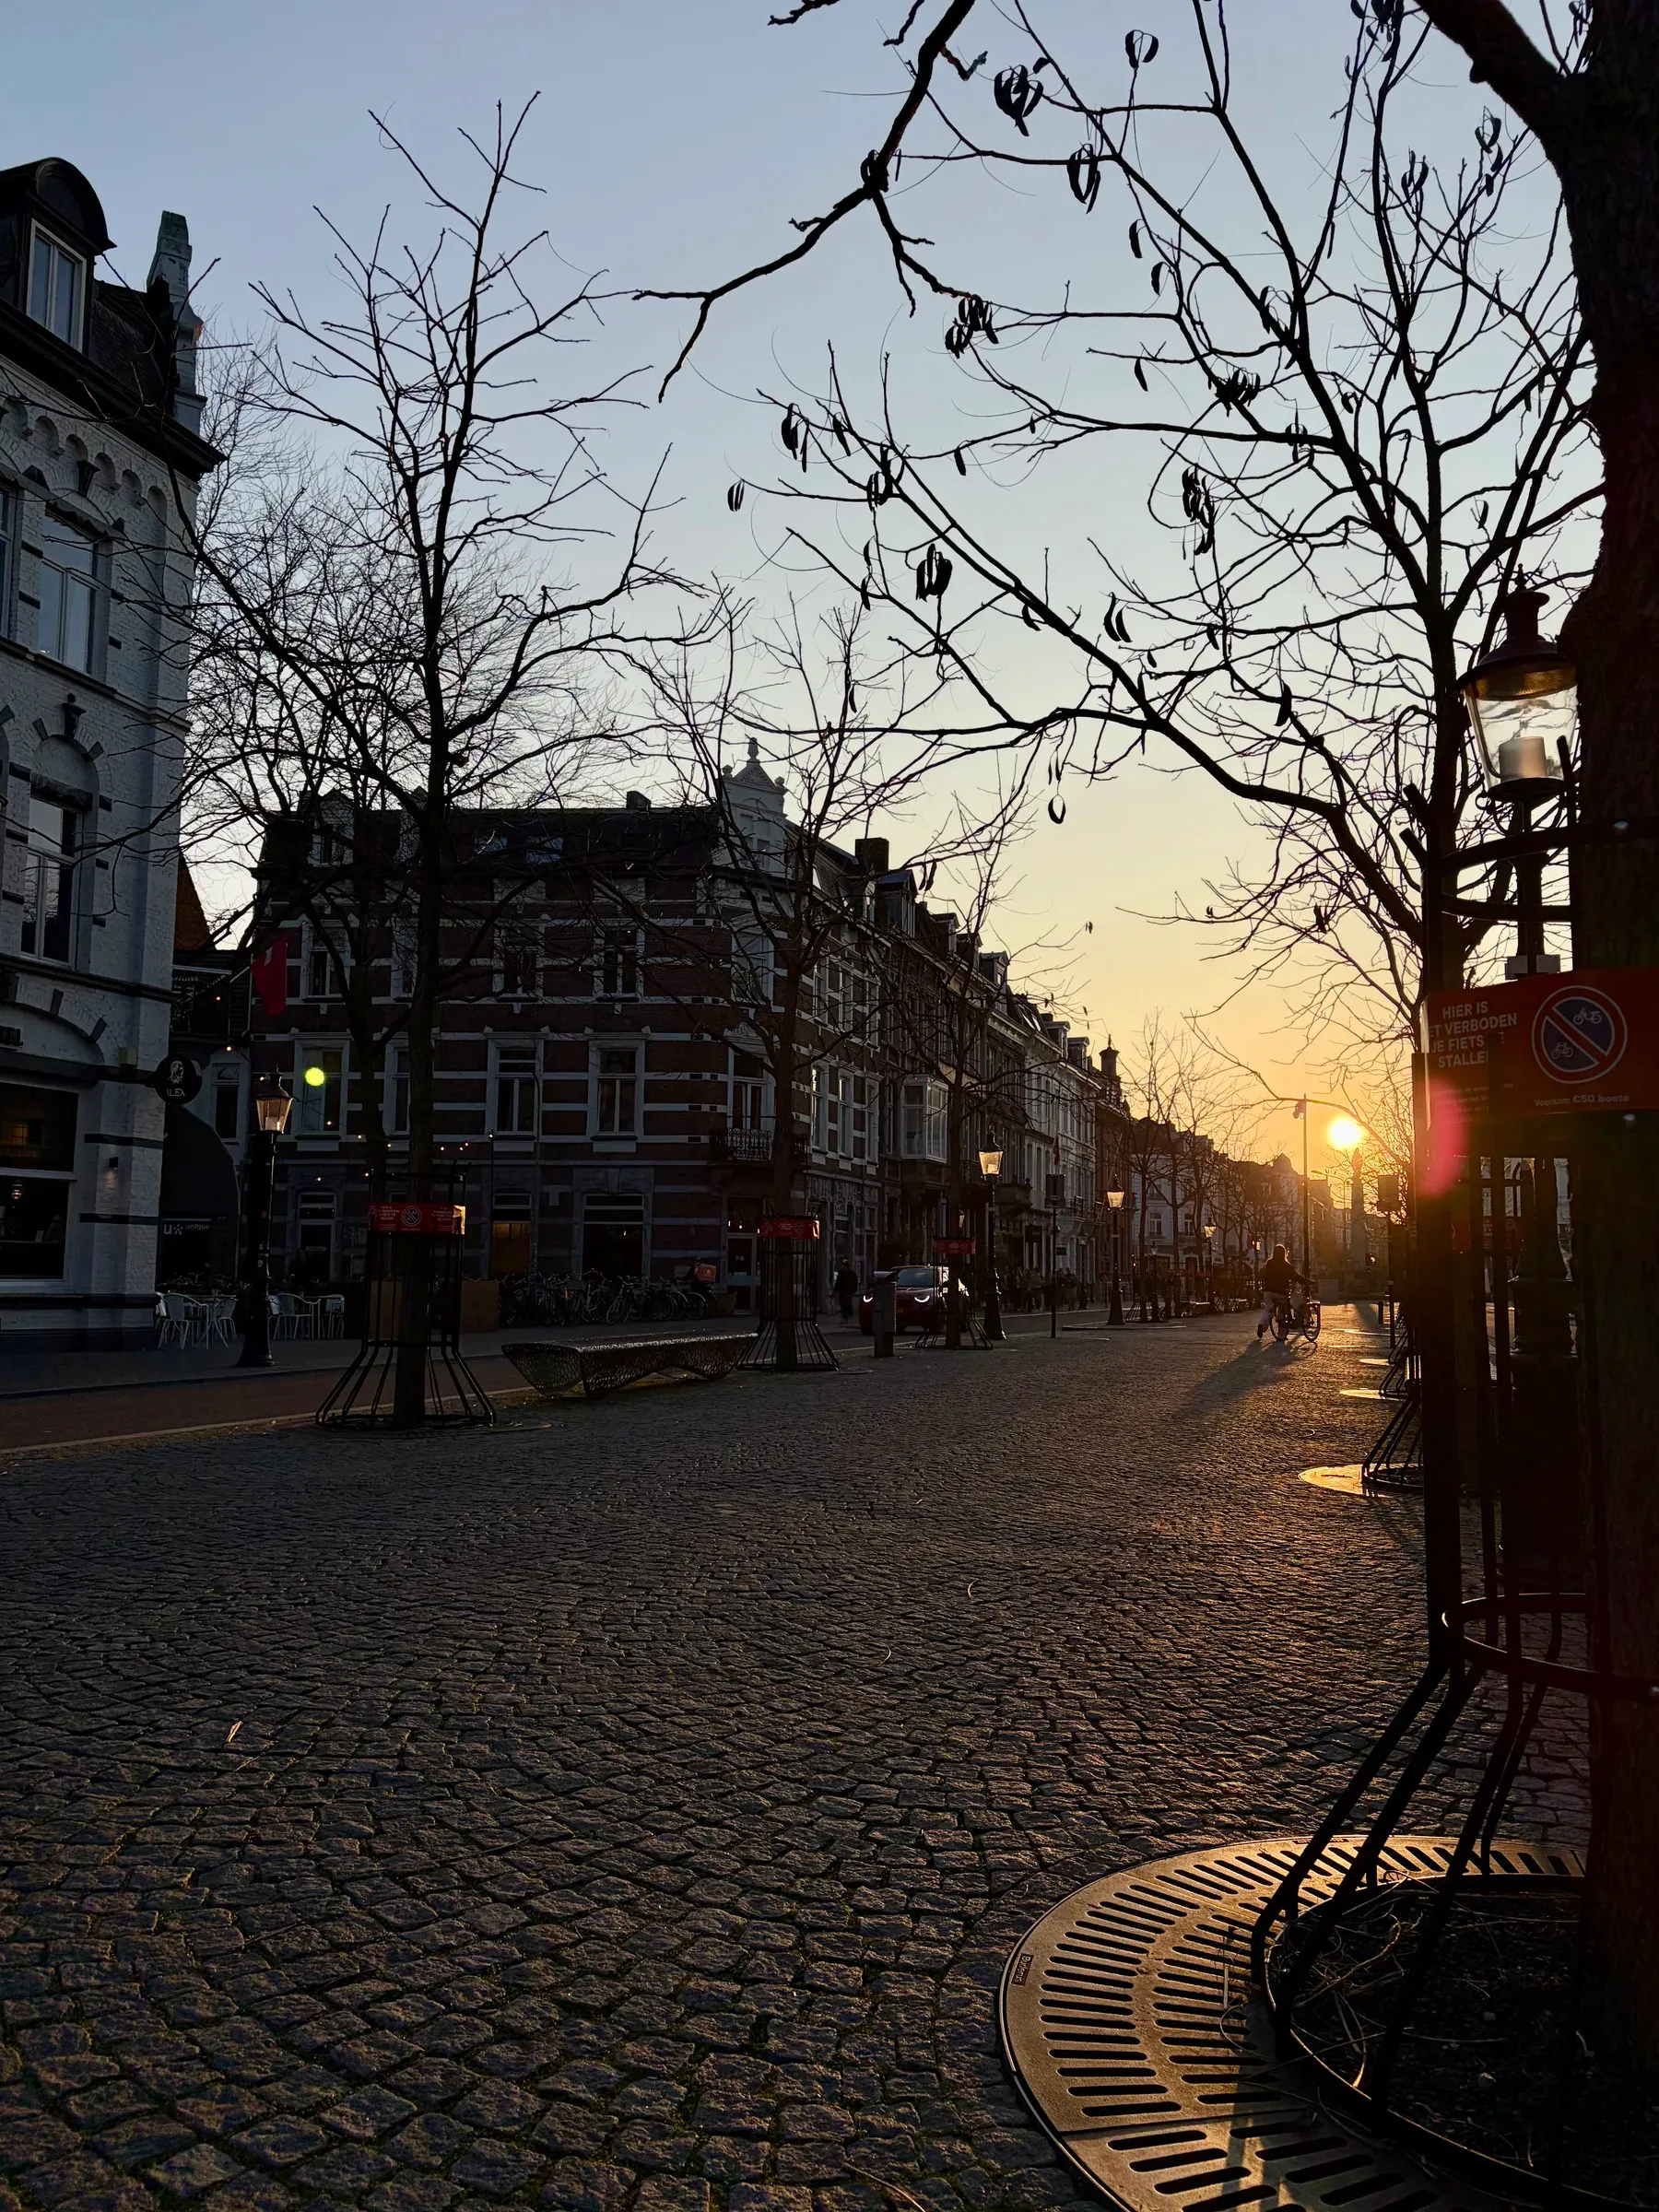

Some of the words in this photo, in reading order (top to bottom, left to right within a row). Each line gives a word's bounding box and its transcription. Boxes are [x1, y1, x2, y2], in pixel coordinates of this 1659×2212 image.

[1442, 1003, 1473, 1019] HIER
[1477, 1001, 1489, 1015] IS
[1429, 1024, 1441, 1038] ET
[1444, 1012, 1518, 1036] VERBODEN
[1430, 1040, 1444, 1053] JE
[1449, 1034, 1485, 1052] FIETS
[1438, 1050, 1488, 1068] STALLE
[1534, 1097, 1571, 1106] Voorkom
[1572, 1094, 1596, 1103] €50
[1597, 1094, 1630, 1103] boete
